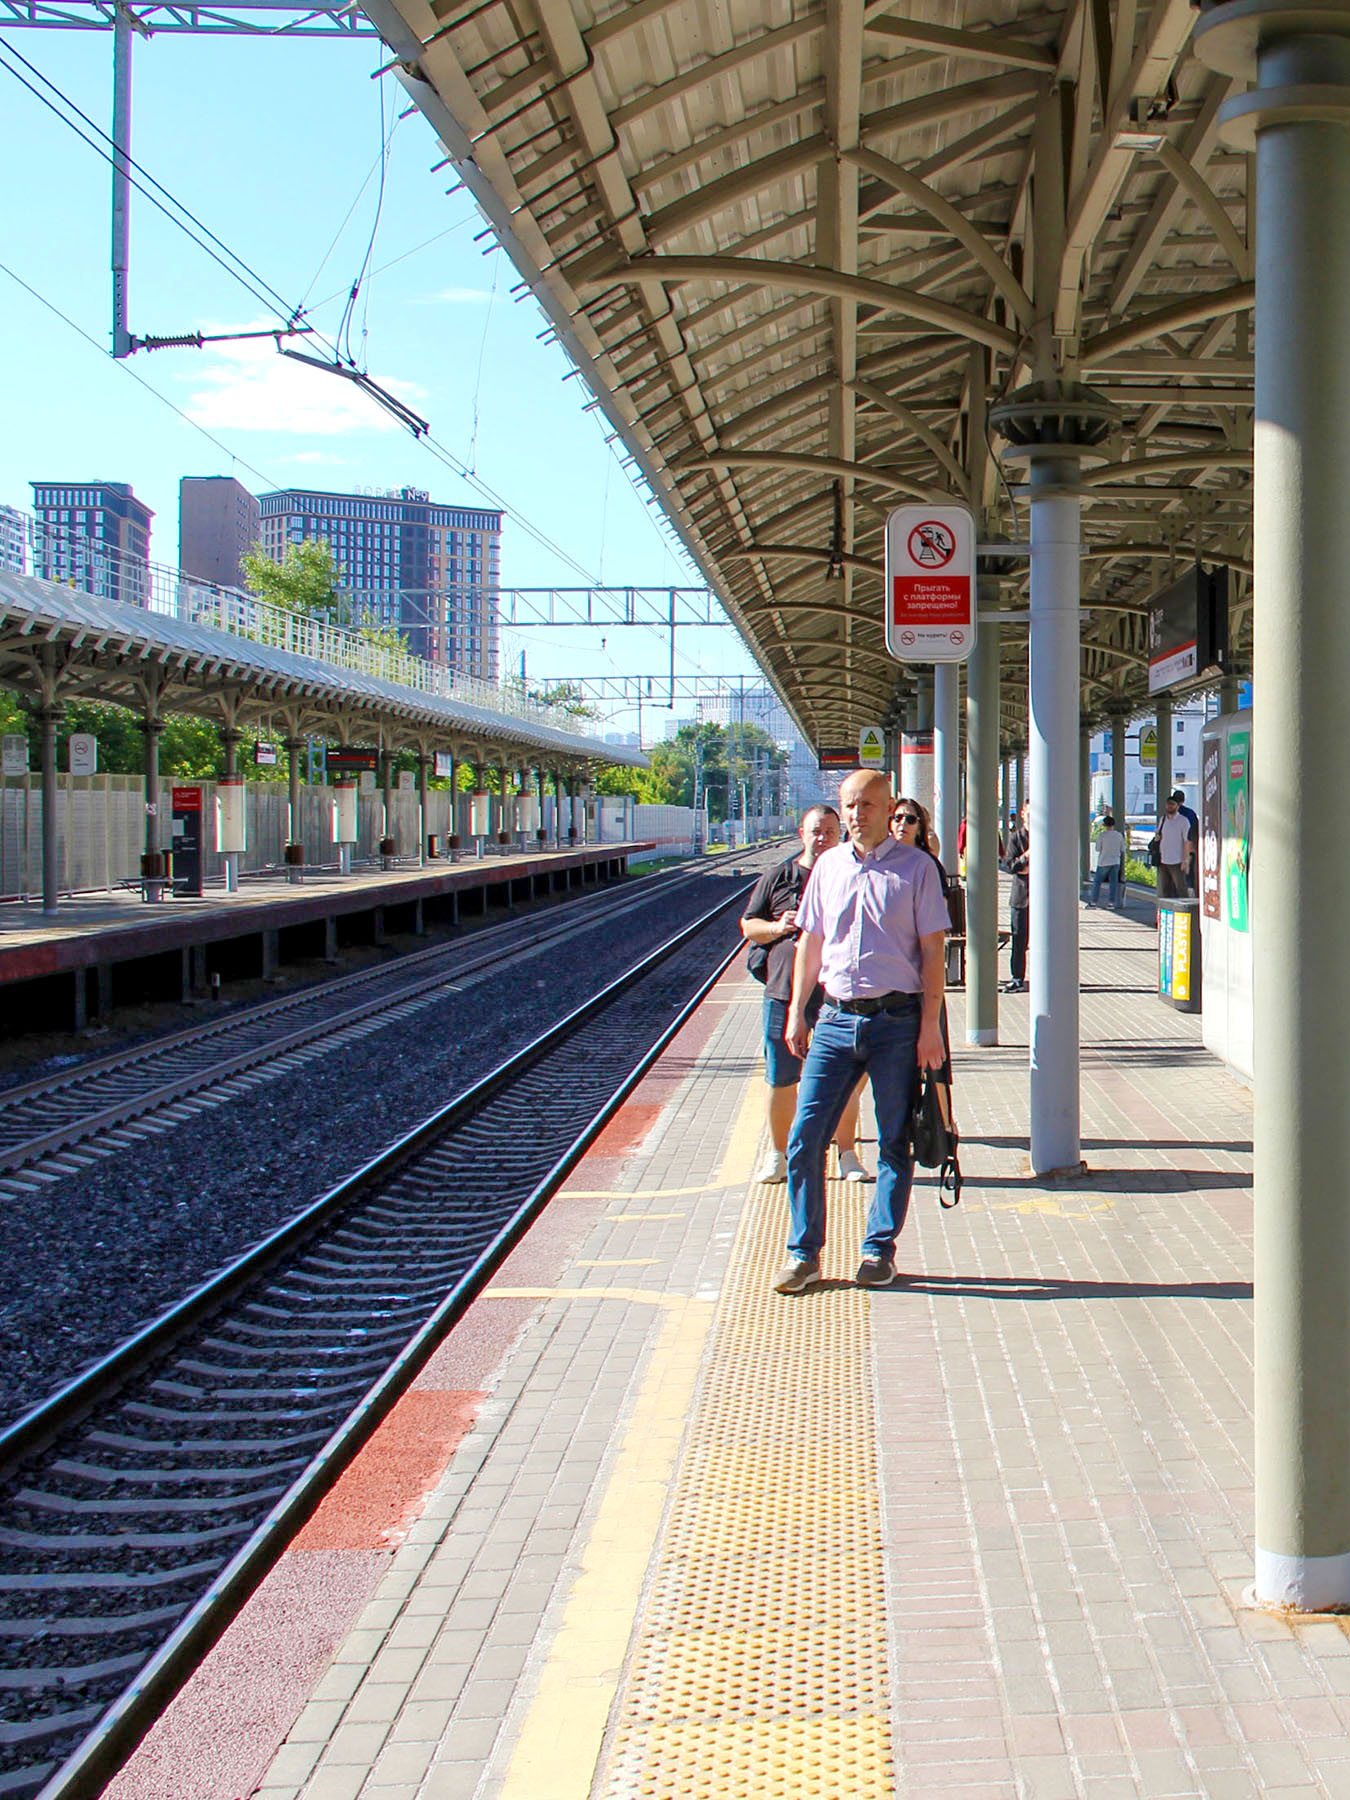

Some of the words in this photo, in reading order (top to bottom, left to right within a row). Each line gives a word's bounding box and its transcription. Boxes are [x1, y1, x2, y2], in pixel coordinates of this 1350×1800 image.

[913, 584, 951, 593] Прыгать
[910, 593, 961, 603] платформы
[907, 601, 958, 611] запрещено!
